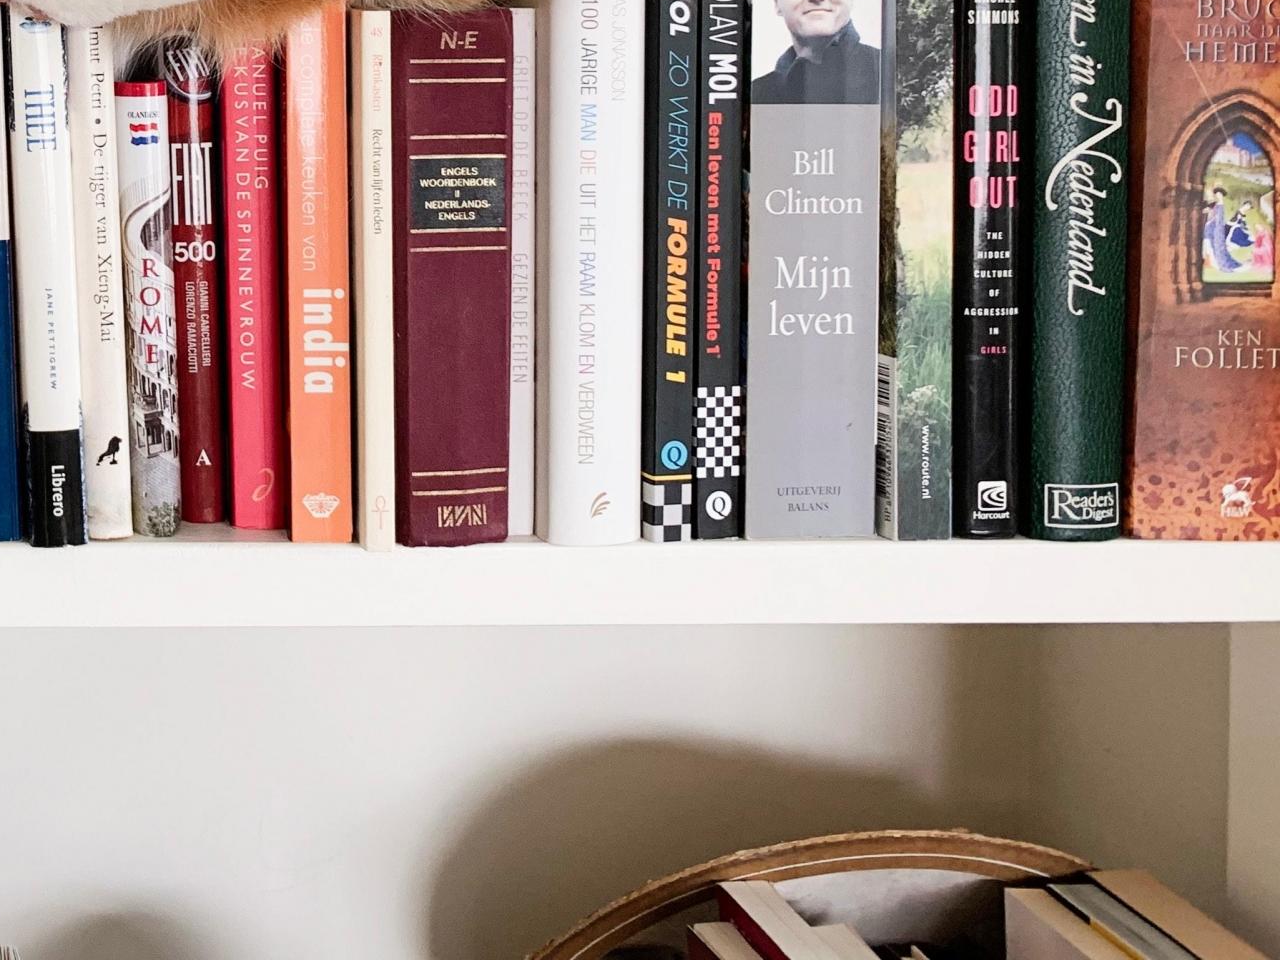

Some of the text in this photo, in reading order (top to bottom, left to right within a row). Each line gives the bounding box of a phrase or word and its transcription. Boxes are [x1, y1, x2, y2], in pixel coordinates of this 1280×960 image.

[967, 10, 1020, 25] SIMMONS
[580, 37, 598, 96] JARIGE
[708, 53, 737, 104] MOL
[1070, 52, 1102, 86] in
[969, 84, 1018, 117] ODD
[708, 112, 723, 150] Een
[964, 130, 1020, 163] GIRL
[254, 135, 269, 189] PUIG
[440, 167, 479, 176] ENGELS
[793, 149, 835, 175] Bill
[171, 142, 213, 226] FIAT
[419, 178, 497, 187] WOORDENBOEK
[708, 155, 723, 208] leven
[969, 176, 1018, 209] OUT
[424, 200, 491, 210] NEDERLANDS-
[665, 50, 689, 384] ZO WERKT DE FORMULE 1
[765, 188, 864, 215] Clinton
[1045, 91, 1123, 316] Nederland
[233, 67, 256, 390] KUS SPINNEVROUW
[708, 213, 721, 253] met
[174, 241, 216, 262] 500
[774, 255, 853, 301] Mijn
[973, 269, 1013, 279] CULTURE
[706, 258, 722, 340] Formule
[964, 306, 1019, 317] AGGRESSION
[768, 300, 855, 337] leven
[303, 288, 350, 393] india
[706, 344, 720, 355] 1
[980, 345, 1008, 355] GIRLS
[1217, 330, 1262, 346] KEN
[46, 321, 65, 517] PETTIGREW Librero
[577, 380, 596, 465] VERDWEEN
[920, 424, 931, 500] www.route.nl
[777, 485, 842, 498] UITGEVERIJ
[787, 501, 830, 512] BALANS
[1051, 490, 1115, 520] Reader's
[973, 510, 1010, 520] Harcourt
[1081, 504, 1114, 521] Digest
